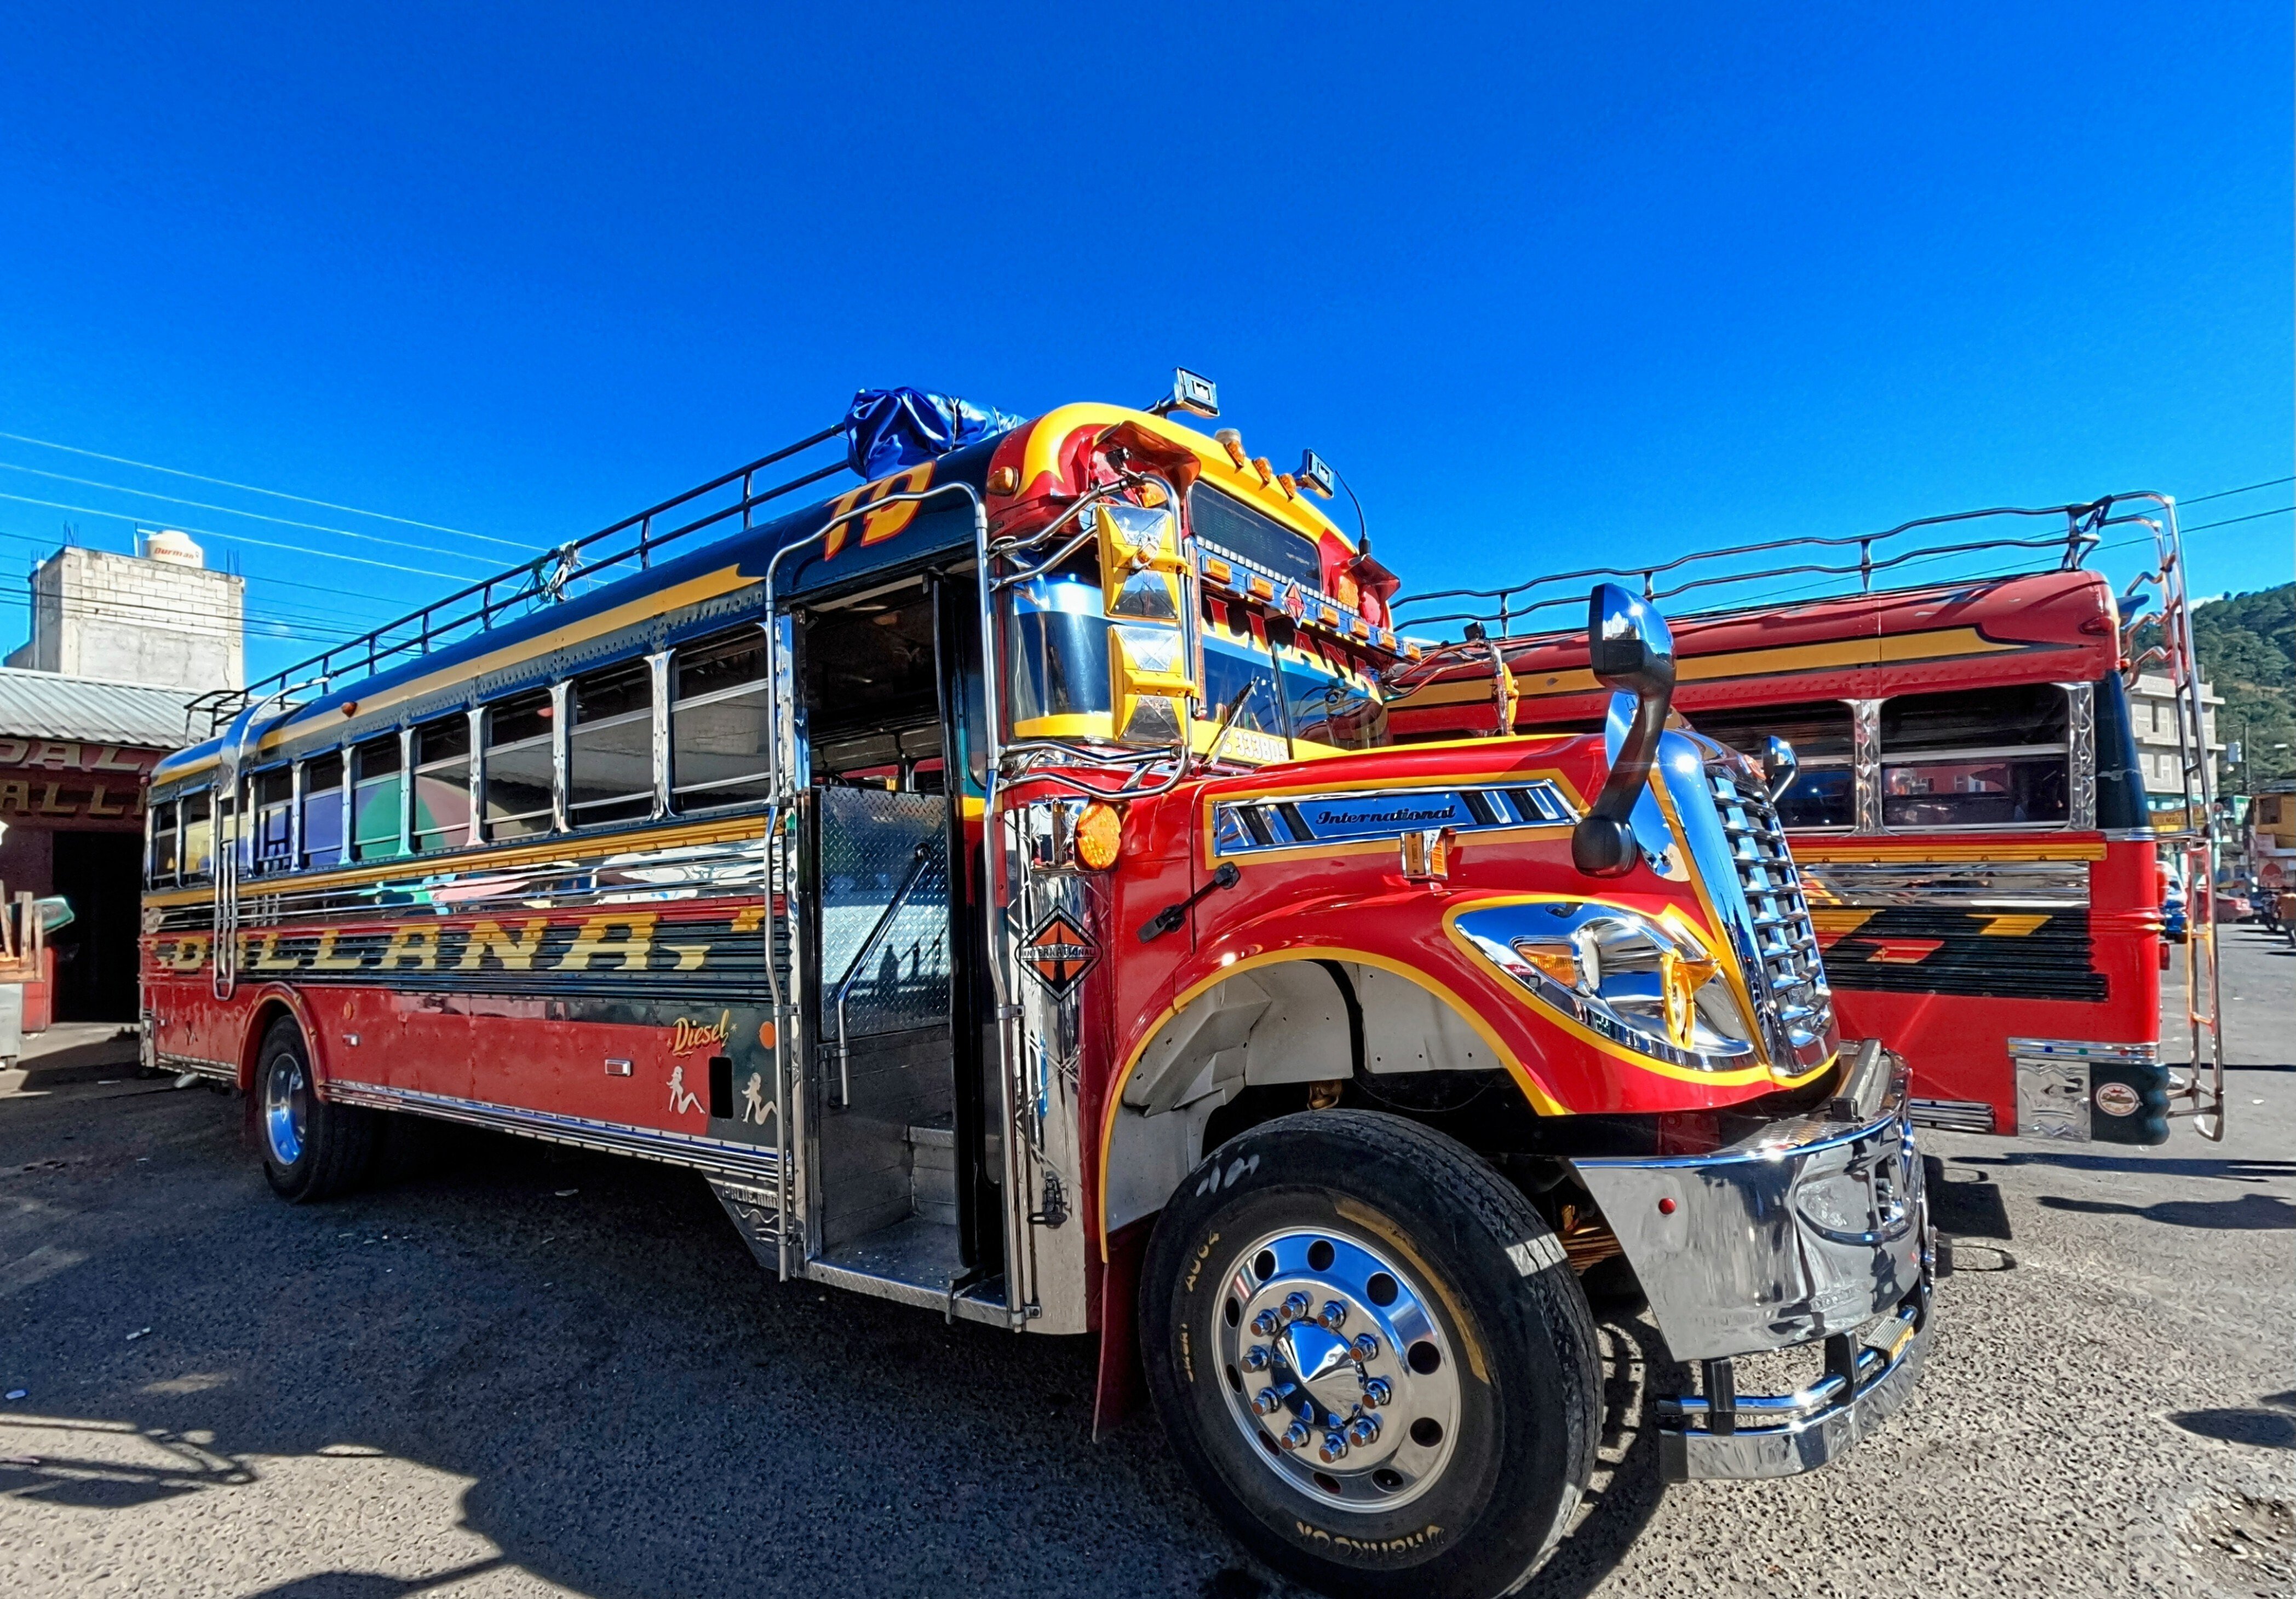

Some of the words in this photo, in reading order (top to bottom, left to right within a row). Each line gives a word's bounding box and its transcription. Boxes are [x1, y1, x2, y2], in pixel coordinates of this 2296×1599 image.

[154, 547, 194, 559] Durman
[1202, 595, 1382, 706] LLANA
[1234, 729, 1289, 763] 333BDS
[1316, 804, 1456, 825] International
[1024, 946, 1094, 957] INTERNATIONAL
[672, 1009, 730, 1057] Diesel
